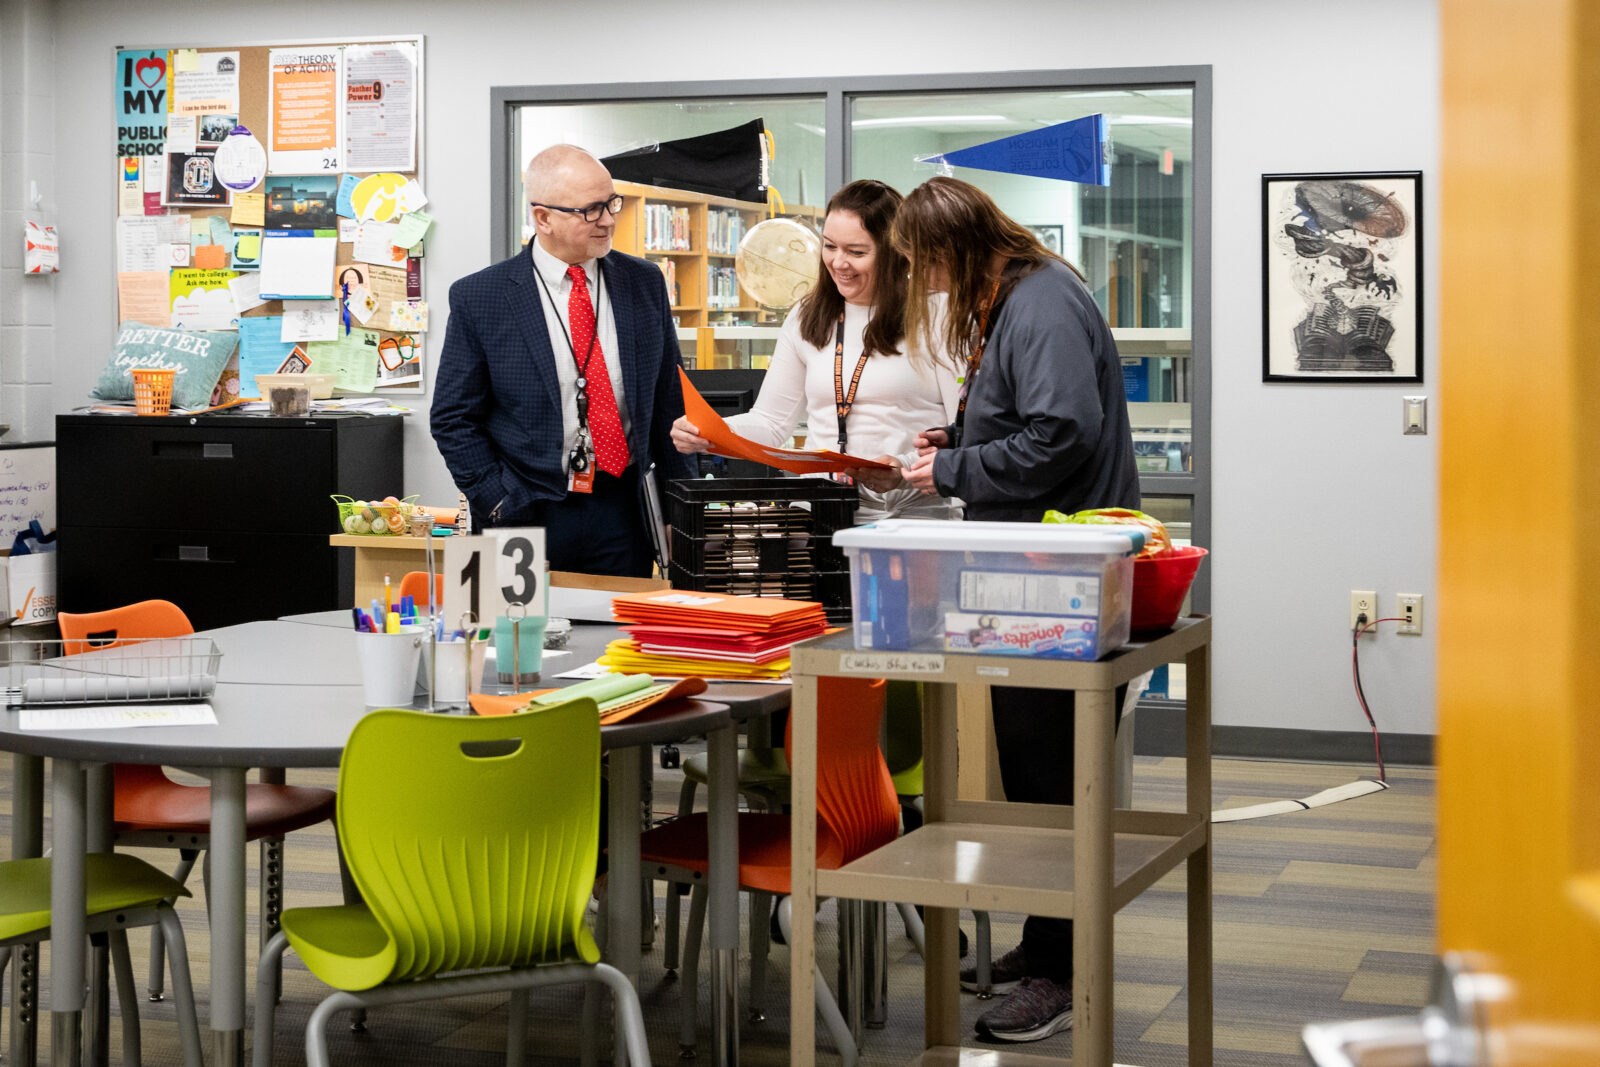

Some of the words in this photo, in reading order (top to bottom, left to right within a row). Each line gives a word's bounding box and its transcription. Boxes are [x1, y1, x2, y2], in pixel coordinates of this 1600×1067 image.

[284, 66, 297, 74] OF
[299, 64, 336, 74] ACTION
[298, 54, 336, 65] THEORY
[124, 58, 133, 87] I
[347, 84, 373, 93] Panther
[347, 93, 373, 101] Power
[373, 81, 382, 100] 9
[124, 90, 166, 114] MY
[322, 158, 338, 169] 24
[117, 328, 211, 357] BETTER
[114, 349, 189, 376] together
[501, 536, 537, 607] 3
[460, 551, 480, 623] 1
[1003, 623, 1065, 648] donettes
